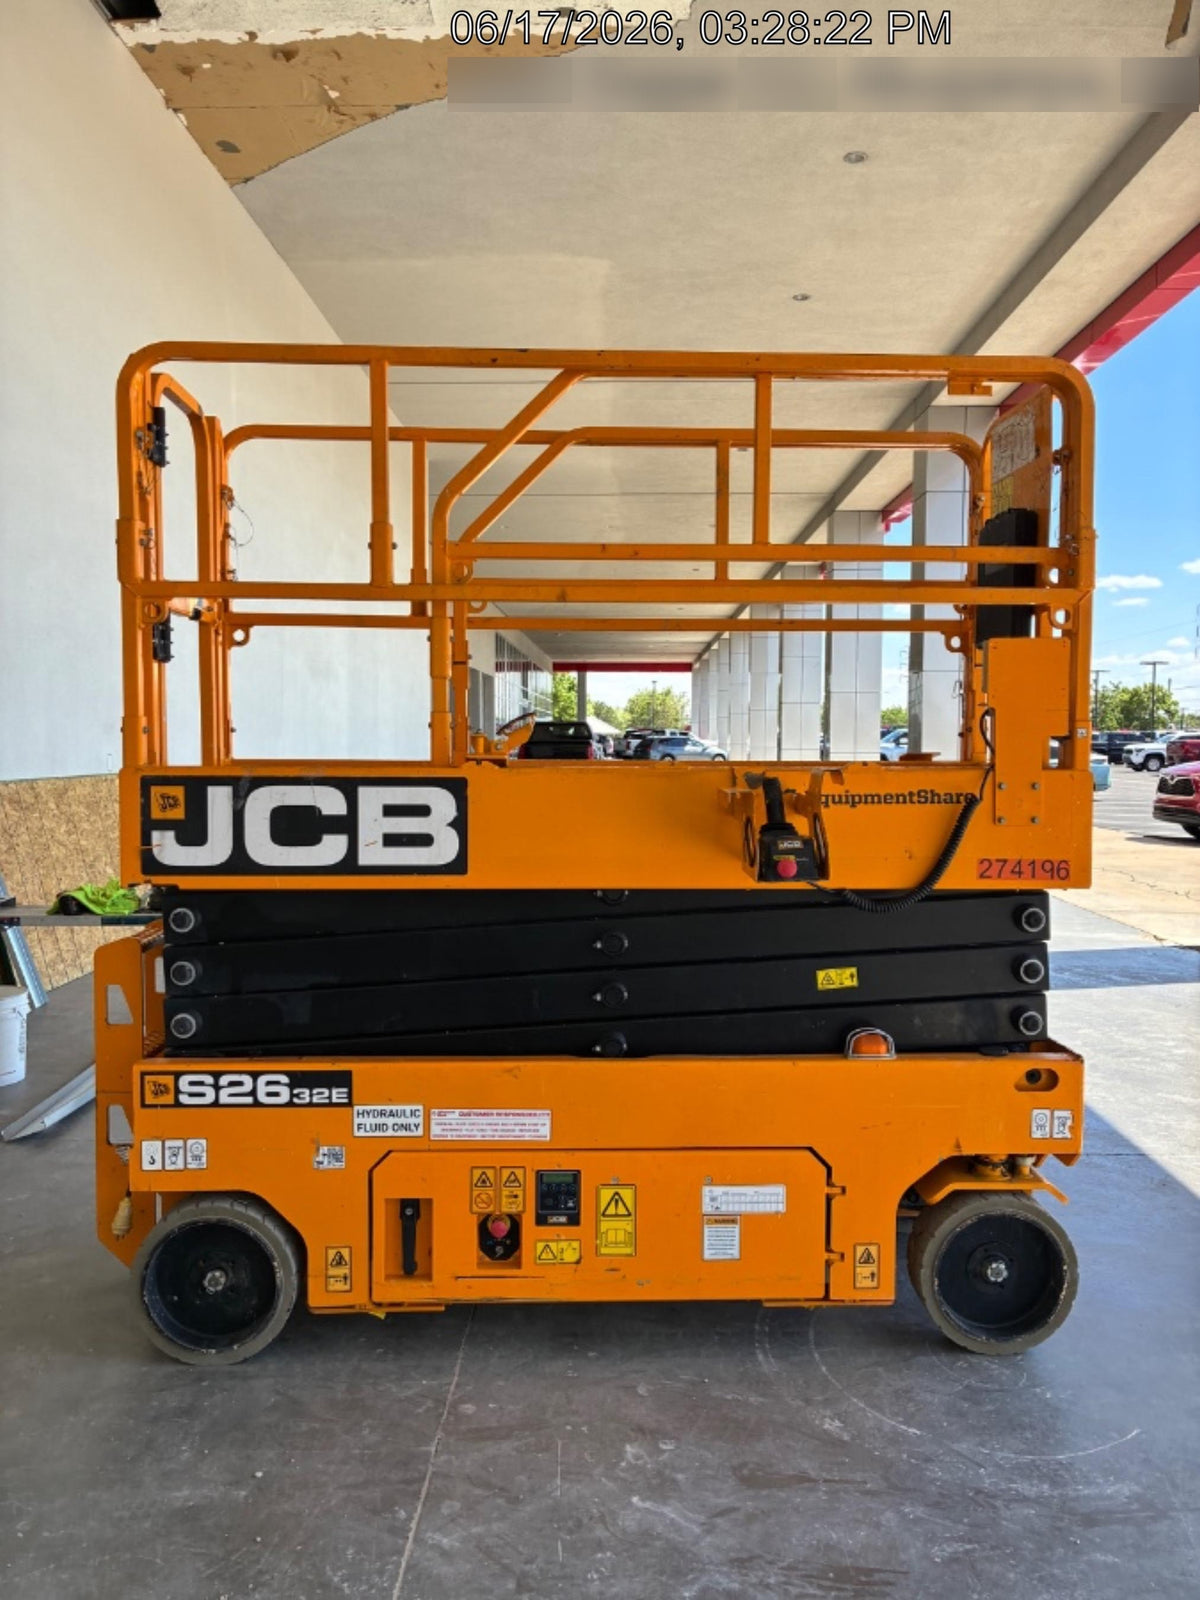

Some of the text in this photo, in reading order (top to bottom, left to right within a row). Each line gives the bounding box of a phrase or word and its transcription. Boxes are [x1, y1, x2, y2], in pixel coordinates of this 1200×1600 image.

[151, 785, 459, 866] JCB
[978, 858, 1070, 880] 274196
[357, 1108, 421, 1119] HYDRAULIC
[357, 1123, 389, 1133] FLUID
[392, 1122, 420, 1133] ONLY
